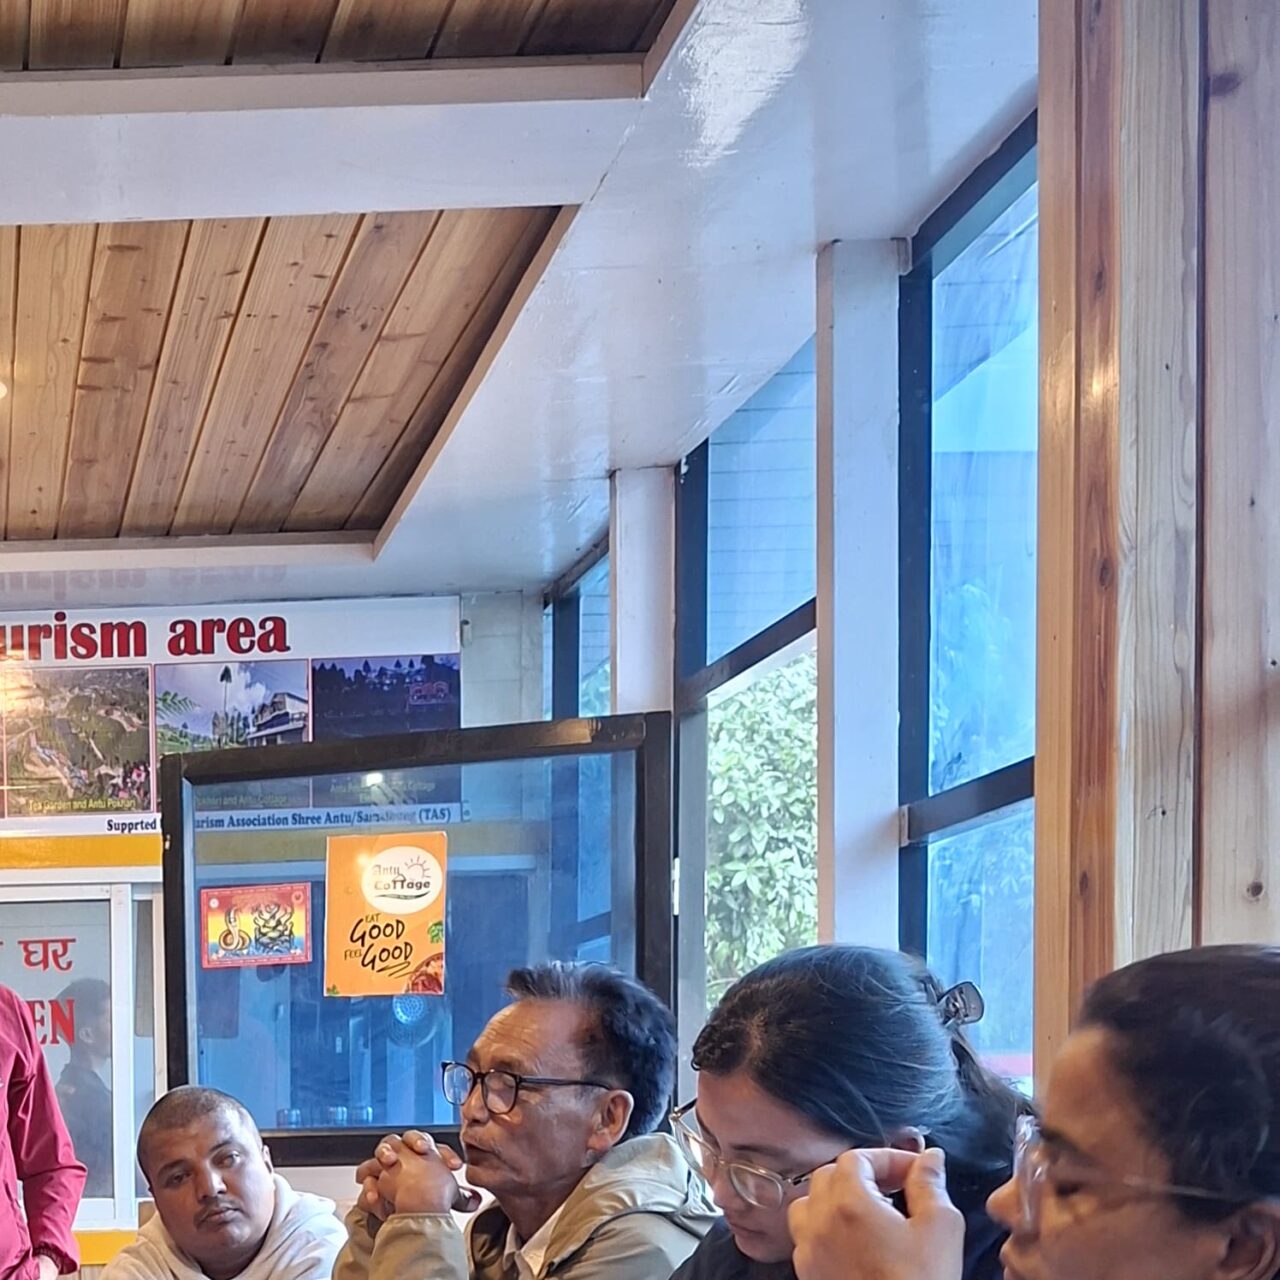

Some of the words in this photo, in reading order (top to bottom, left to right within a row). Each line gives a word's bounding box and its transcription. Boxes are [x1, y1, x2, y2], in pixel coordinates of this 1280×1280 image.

[167, 615, 291, 656] area
[88, 798, 106, 809] Antu
[107, 818, 157, 833] Supprted
[227, 813, 288, 827] Association
[291, 812, 322, 825] Shree
[418, 807, 451, 824] (TAS)
[349, 918, 405, 947] GOOD
[365, 913, 381, 923] EAT
[17, 938, 76, 972] घर
[344, 949, 362, 961] FEEL
[361, 941, 413, 971] GOOD
